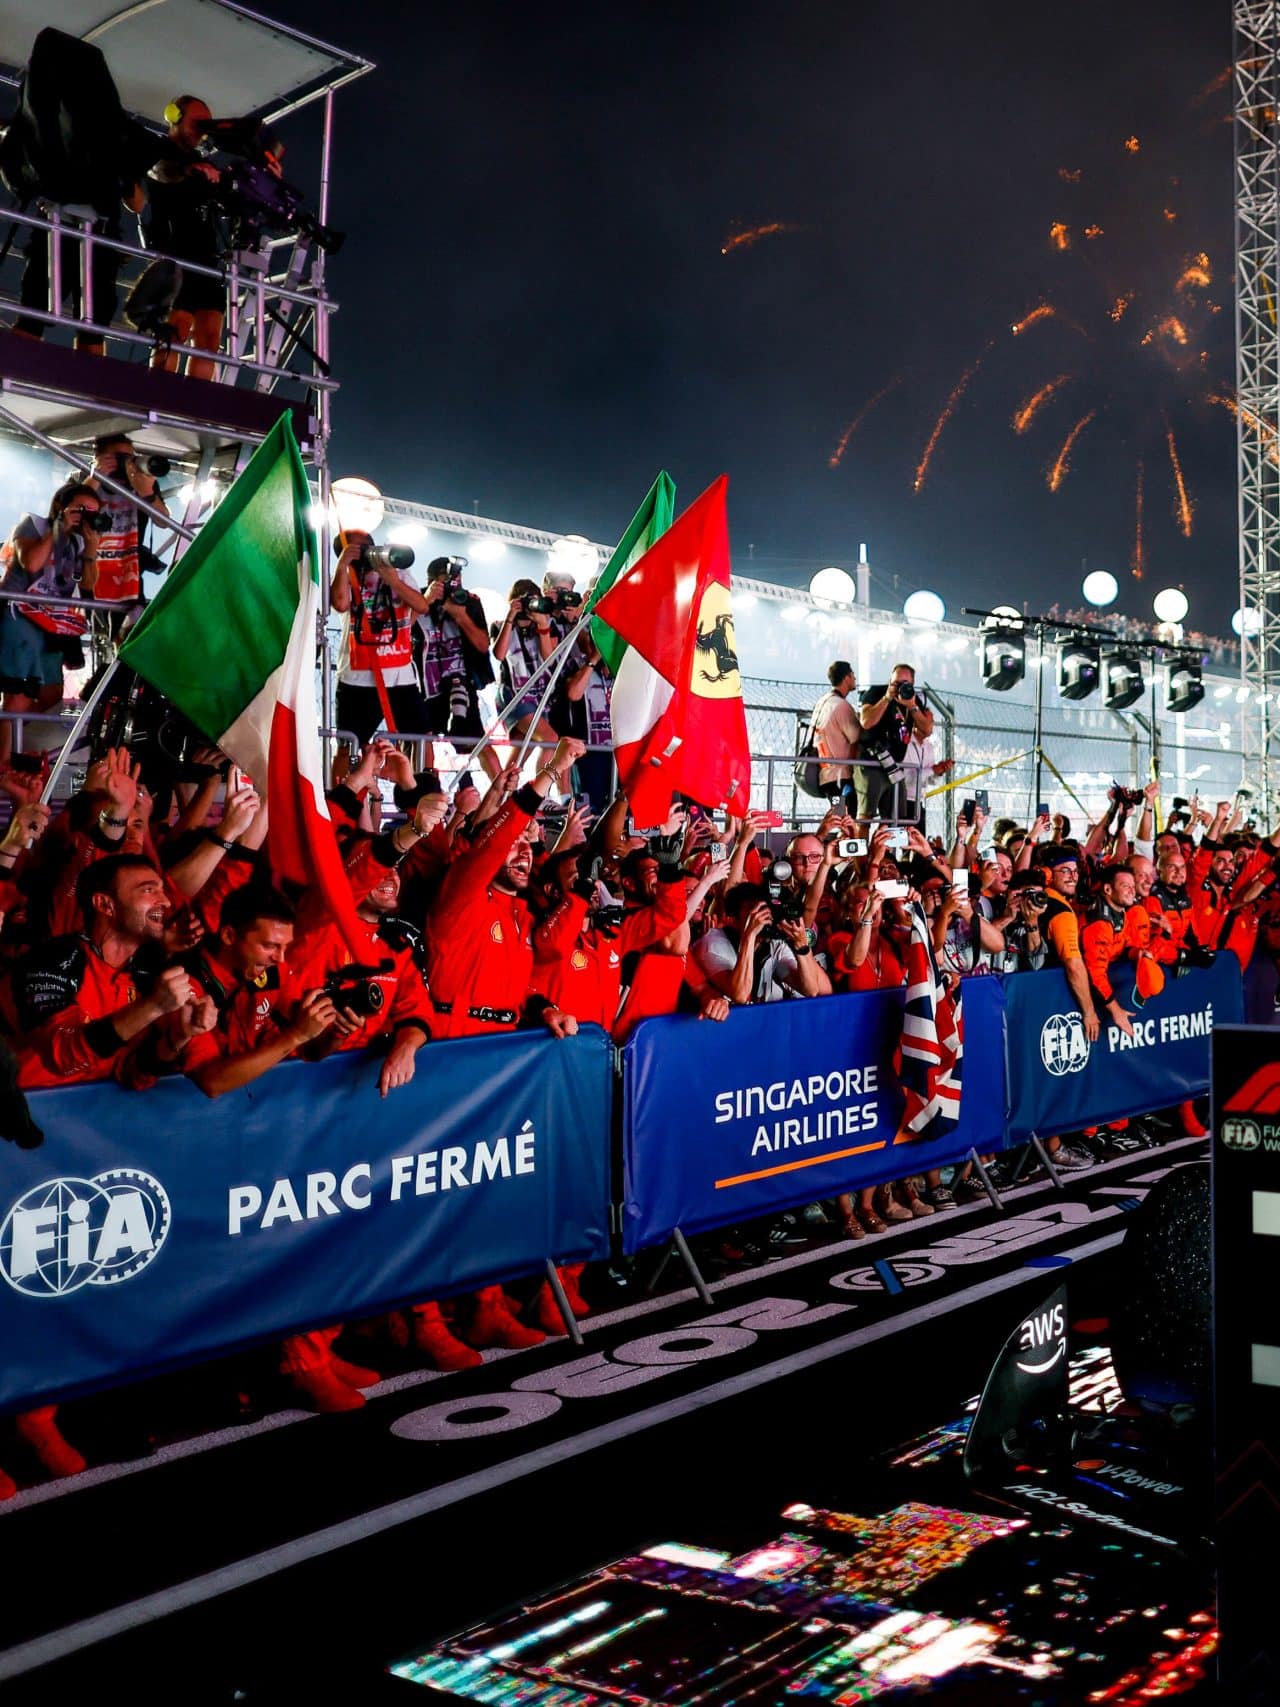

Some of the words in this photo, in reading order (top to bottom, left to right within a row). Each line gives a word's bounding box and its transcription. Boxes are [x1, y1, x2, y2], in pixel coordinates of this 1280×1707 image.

[1160, 1002, 1213, 1043] FERMÉ
[714, 1065, 879, 1124] SINGAPORE
[751, 1101, 879, 1156] AIRLINES
[228, 1163, 372, 1235] PARC
[391, 1120, 535, 1201] FERMÉ
[1020, 1303, 1065, 1350] aws
[1096, 1464, 1184, 1495] V-Power
